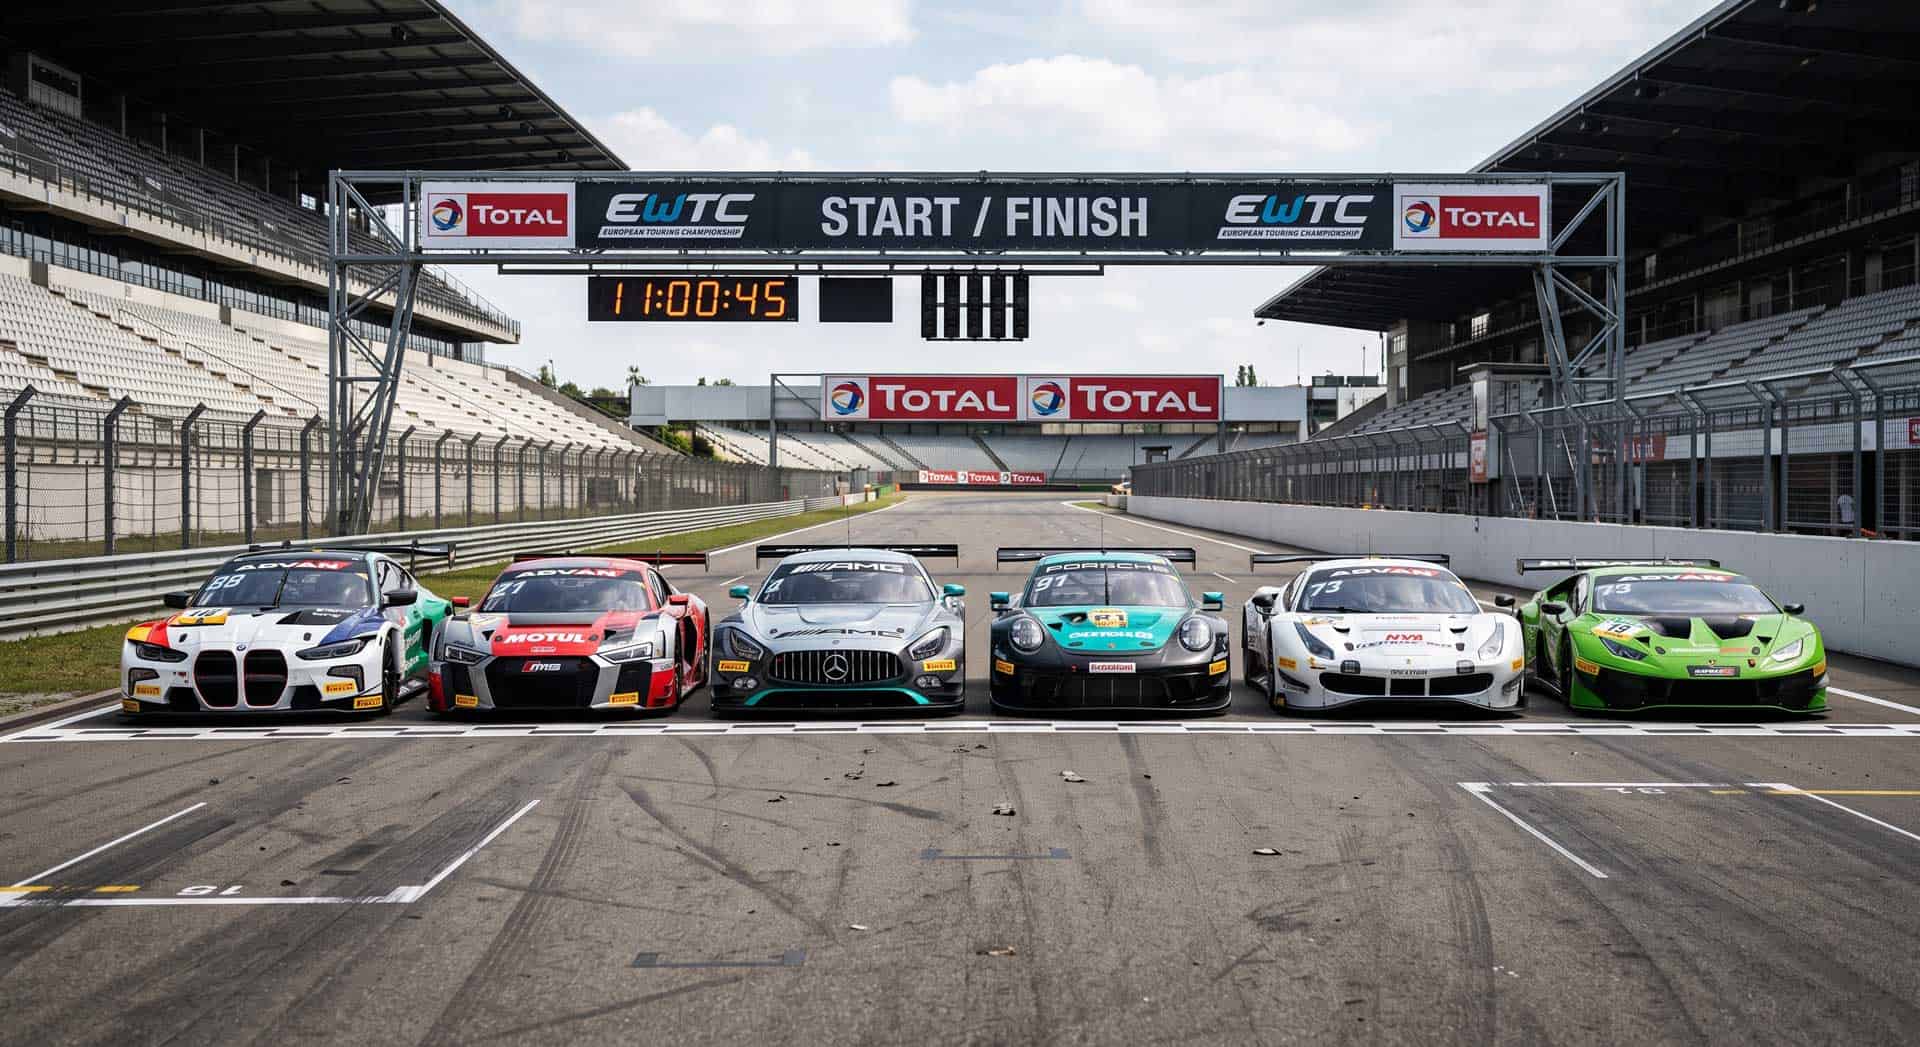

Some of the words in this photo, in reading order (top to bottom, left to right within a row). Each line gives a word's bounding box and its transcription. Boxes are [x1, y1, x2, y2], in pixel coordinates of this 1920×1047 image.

[471, 205, 563, 225] TOTAL
[605, 193, 755, 223] EWTC
[820, 196, 960, 237] START
[972, 196, 992, 237] /
[1006, 196, 1148, 237] FINISH
[1224, 194, 1375, 224] EWTC
[1444, 207, 1535, 228] TOTAL
[615, 281, 786, 317] 11:00:45
[876, 384, 1010, 412] TOTAL
[1077, 385, 1211, 413] TOTAL
[928, 472, 956, 482] TOTAL
[969, 473, 998, 483] TOTAL
[1012, 473, 1043, 483] TOTAL
[235, 561, 339, 571] ADVAN
[516, 569, 617, 578] ADVAN
[1046, 563, 1170, 574] PORSCHE
[1330, 567, 1433, 577] ADVAN
[1035, 575, 1067, 593] 91
[1616, 574, 1729, 582] ADVAN
[1311, 580, 1344, 598] 73
[503, 632, 586, 644] MOTUL
